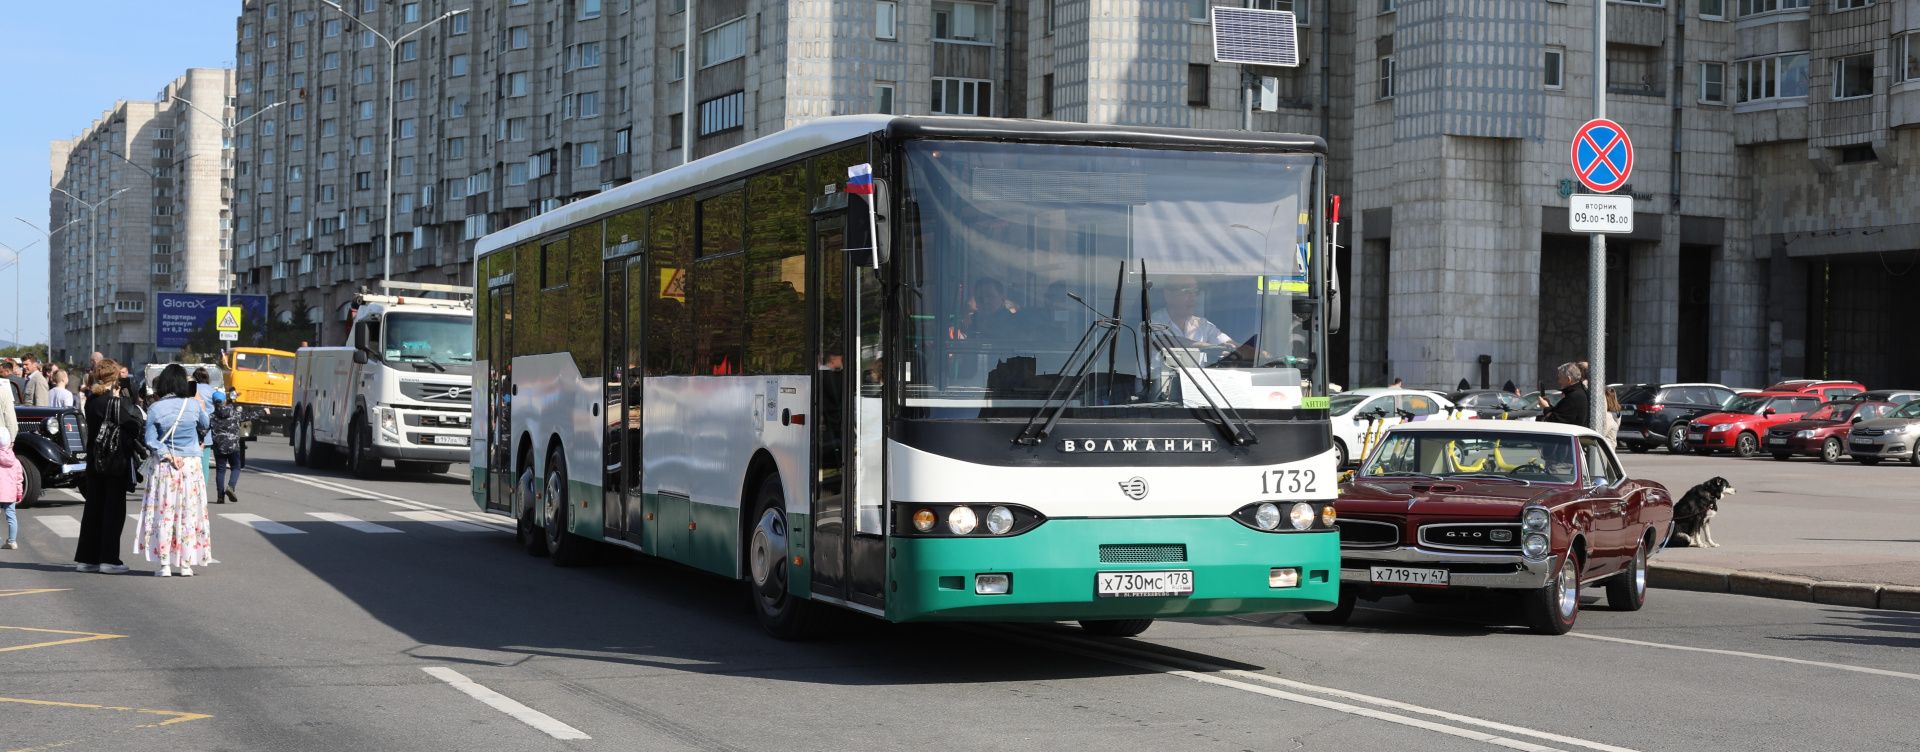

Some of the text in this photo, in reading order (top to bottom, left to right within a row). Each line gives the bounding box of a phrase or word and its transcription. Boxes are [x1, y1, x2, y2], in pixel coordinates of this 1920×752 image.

[1585, 203, 1617, 211] вторник
[162, 298, 206, 309] GloraX
[1064, 440, 1212, 452] ВОЛЖАНИН
[1261, 469, 1317, 494] 1732
[1167, 573, 1189, 585] 178
[1431, 570, 1444, 580] 47
